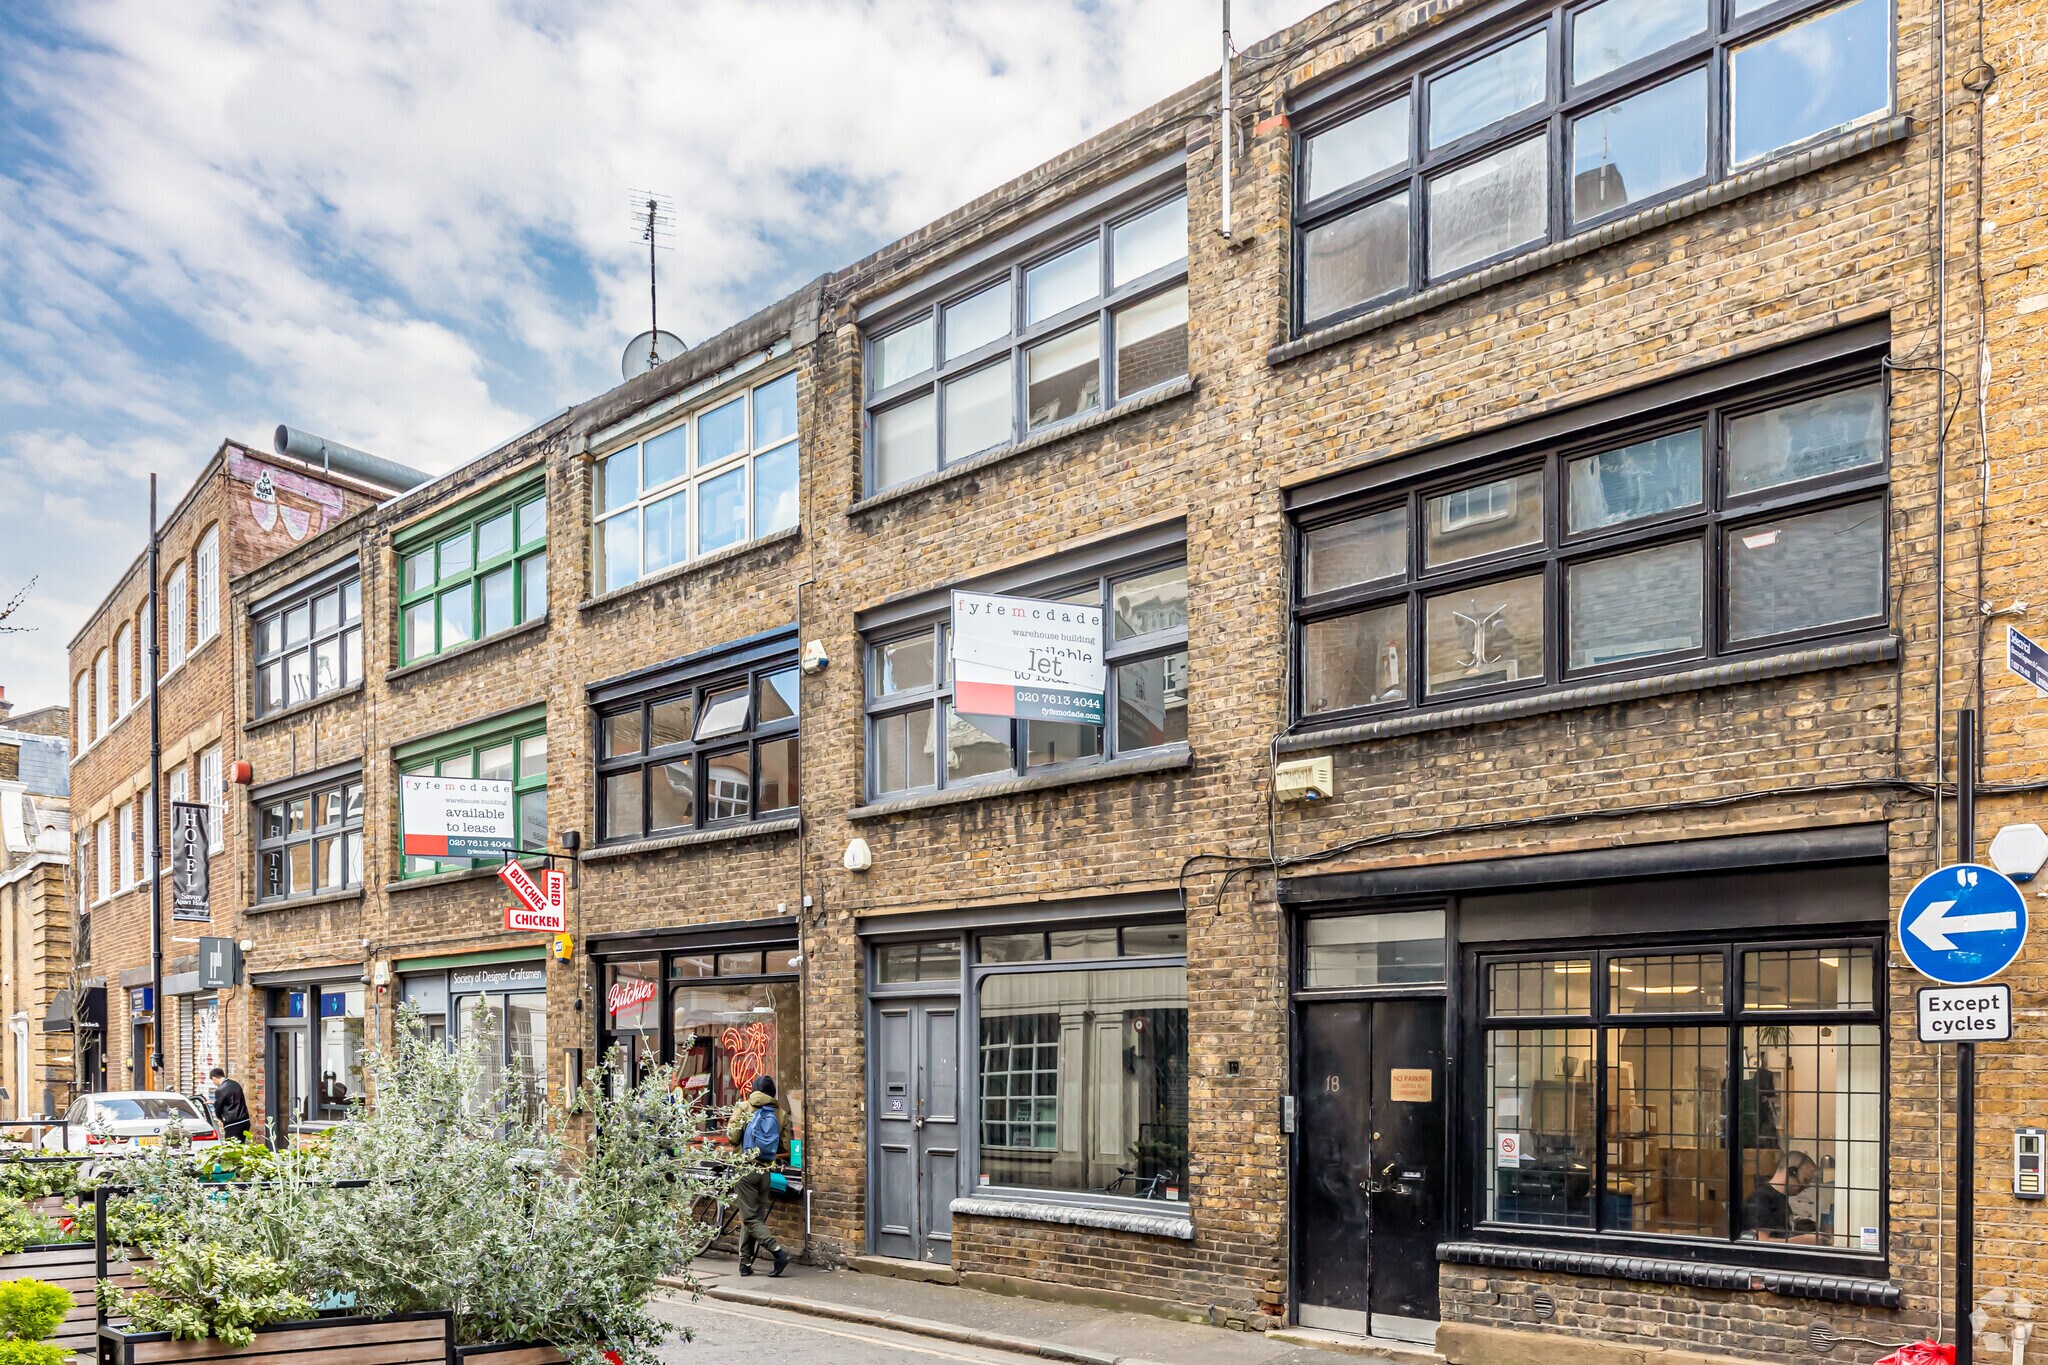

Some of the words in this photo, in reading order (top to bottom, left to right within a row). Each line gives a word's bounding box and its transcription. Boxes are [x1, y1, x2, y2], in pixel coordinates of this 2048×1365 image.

[958, 600, 1100, 626] fyfemcdade
[1012, 628, 1059, 641] warehouse
[1061, 632, 1096, 645] building
[1028, 650, 1063, 677] let
[1016, 692, 1039, 703] 020
[1042, 694, 1070, 705] 7613
[1073, 697, 1101, 709] 4044
[405, 780, 510, 793] fyfemcdade
[446, 808, 505, 819] available
[446, 822, 460, 832] to
[463, 823, 496, 833] lease
[184, 813, 198, 887] HOTEL
[181, 893, 202, 901] Savoy
[509, 869, 547, 911] BUTCHIES
[550, 876, 561, 907] FRIED
[515, 913, 560, 928] CHICKEN
[453, 972, 474, 986] Society
[475, 971, 481, 982] of
[482, 971, 509, 985] Designer
[509, 968, 542, 981] Craftsmen
[608, 979, 654, 1012] Butchies
[1929, 994, 2000, 1012] Except
[1932, 1016, 1996, 1034] cycles
[1326, 1075, 1340, 1092] 18
[892, 1101, 902, 1109] 20
